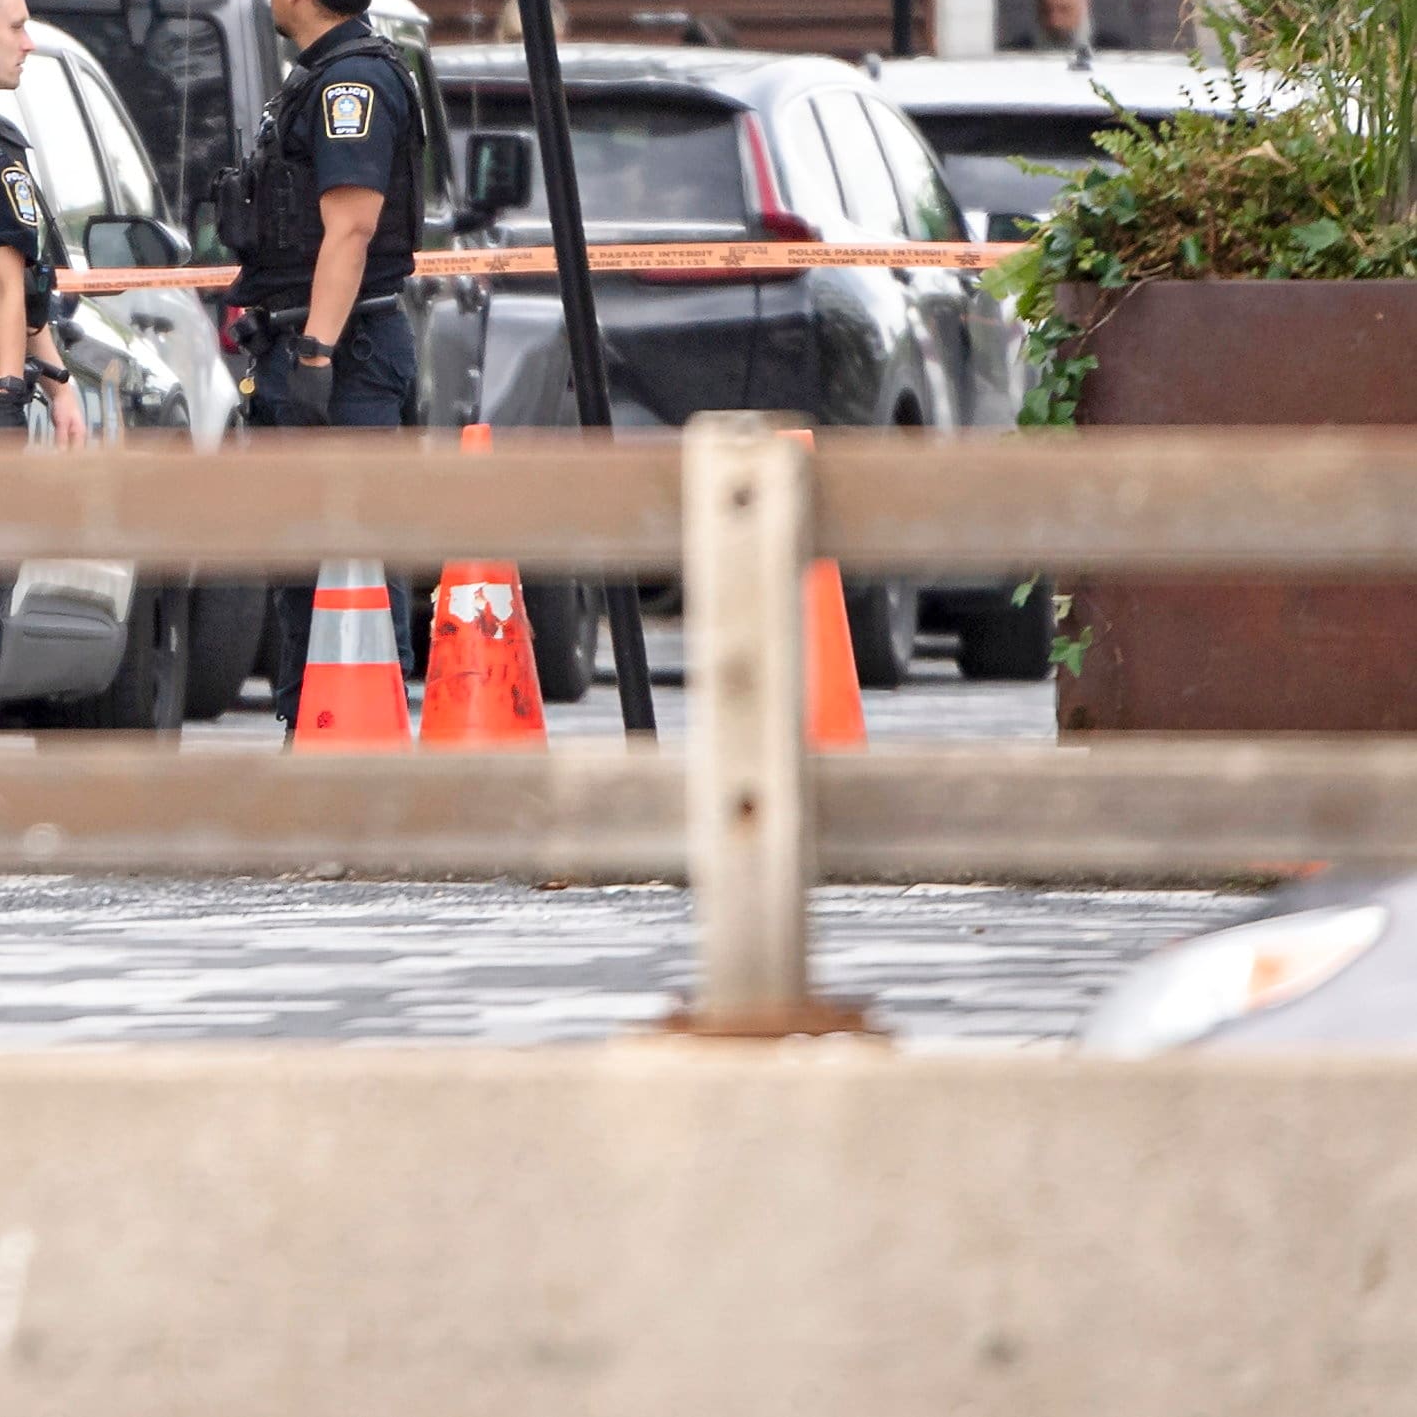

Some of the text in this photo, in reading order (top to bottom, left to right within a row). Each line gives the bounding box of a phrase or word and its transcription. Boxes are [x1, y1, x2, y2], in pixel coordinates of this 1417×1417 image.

[327, 86, 368, 99] POLICE
[599, 250, 654, 259] PASSAGE
[658, 249, 714, 258] INTERDIT
[787, 248, 948, 257] POLICE PASSAGE INTERDIT
[423, 256, 479, 265] INTERDIT
[788, 257, 858, 266] INFO-CRIME
[83, 280, 153, 290] INFO-CRIME
